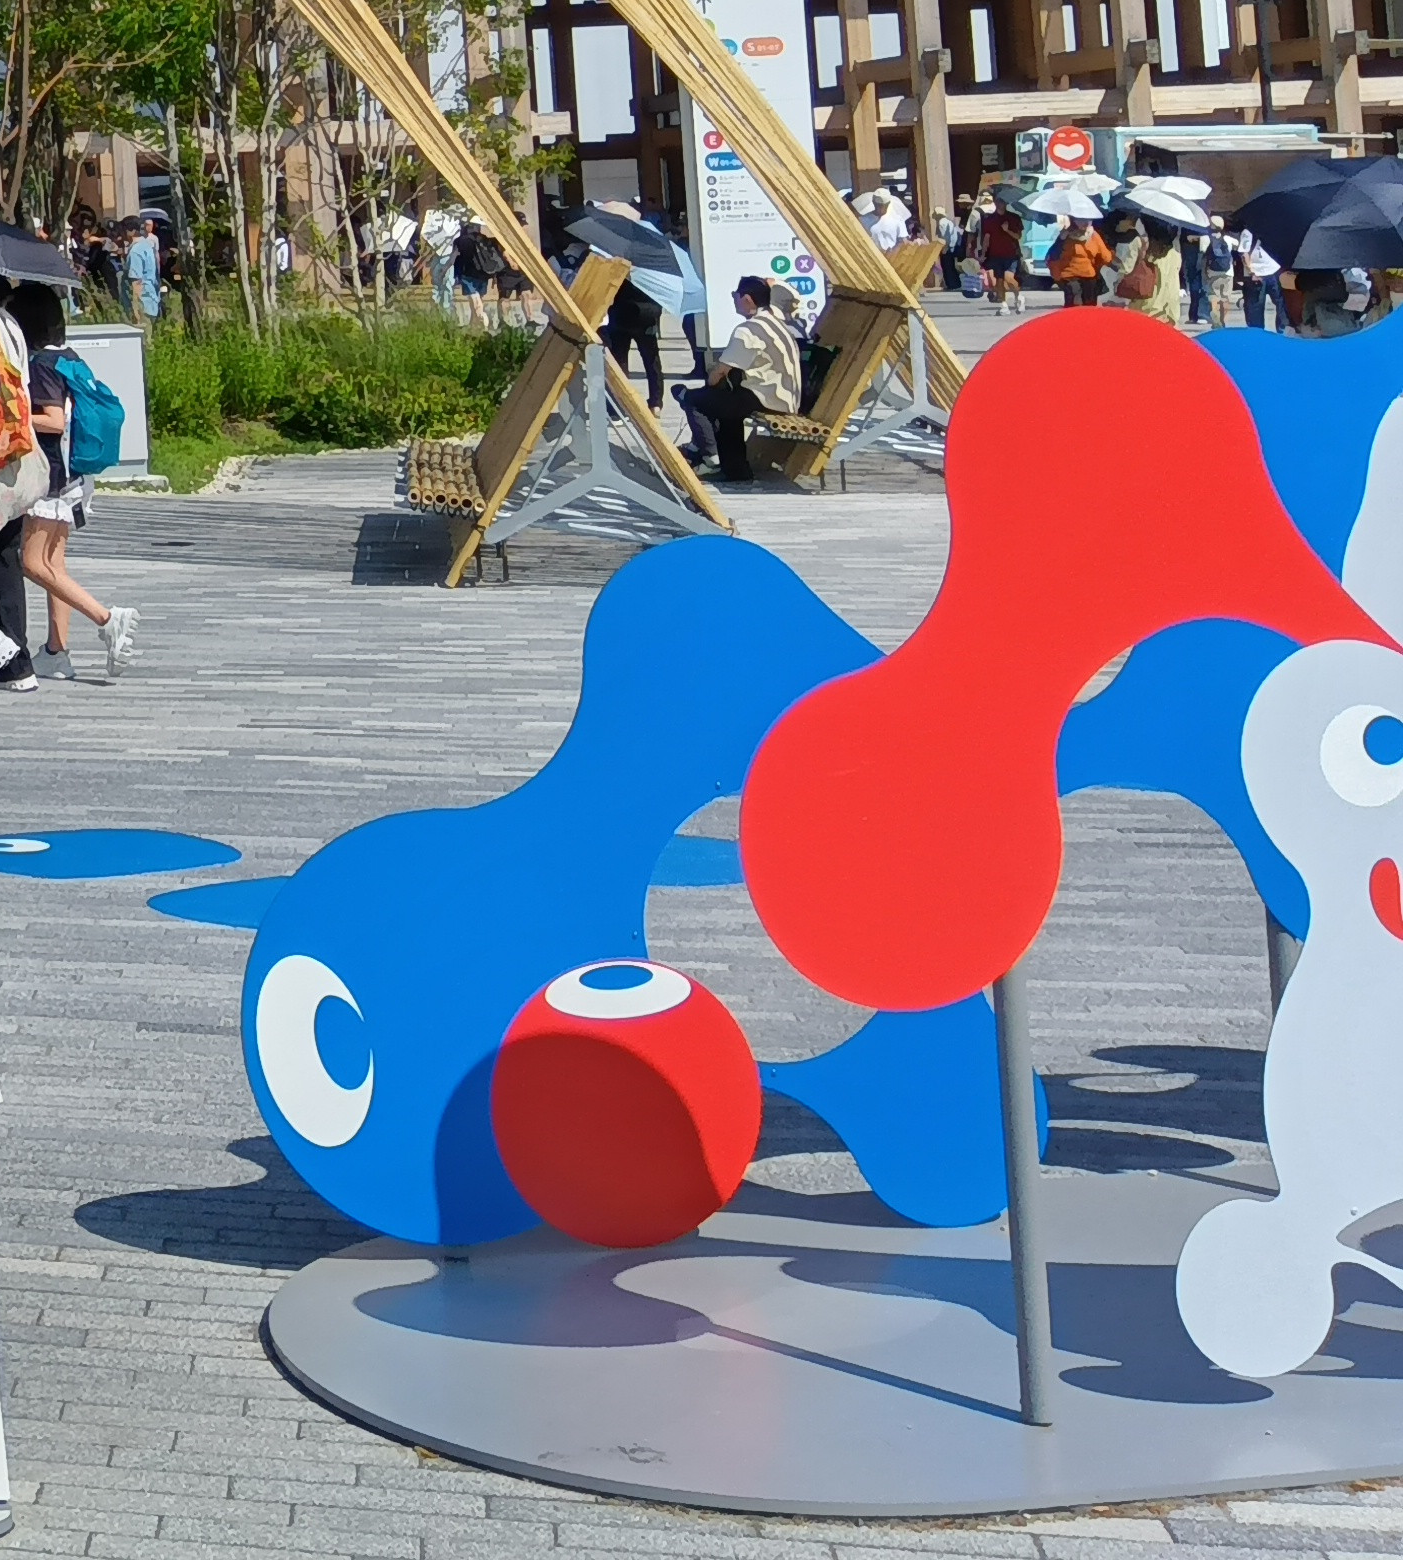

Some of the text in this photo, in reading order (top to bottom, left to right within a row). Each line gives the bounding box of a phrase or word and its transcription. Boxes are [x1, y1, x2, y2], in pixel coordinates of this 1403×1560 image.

[747, 42, 755, 52] S
[709, 134, 718, 146] E
[708, 157, 719, 168] W
[776, 258, 809, 270] P X
